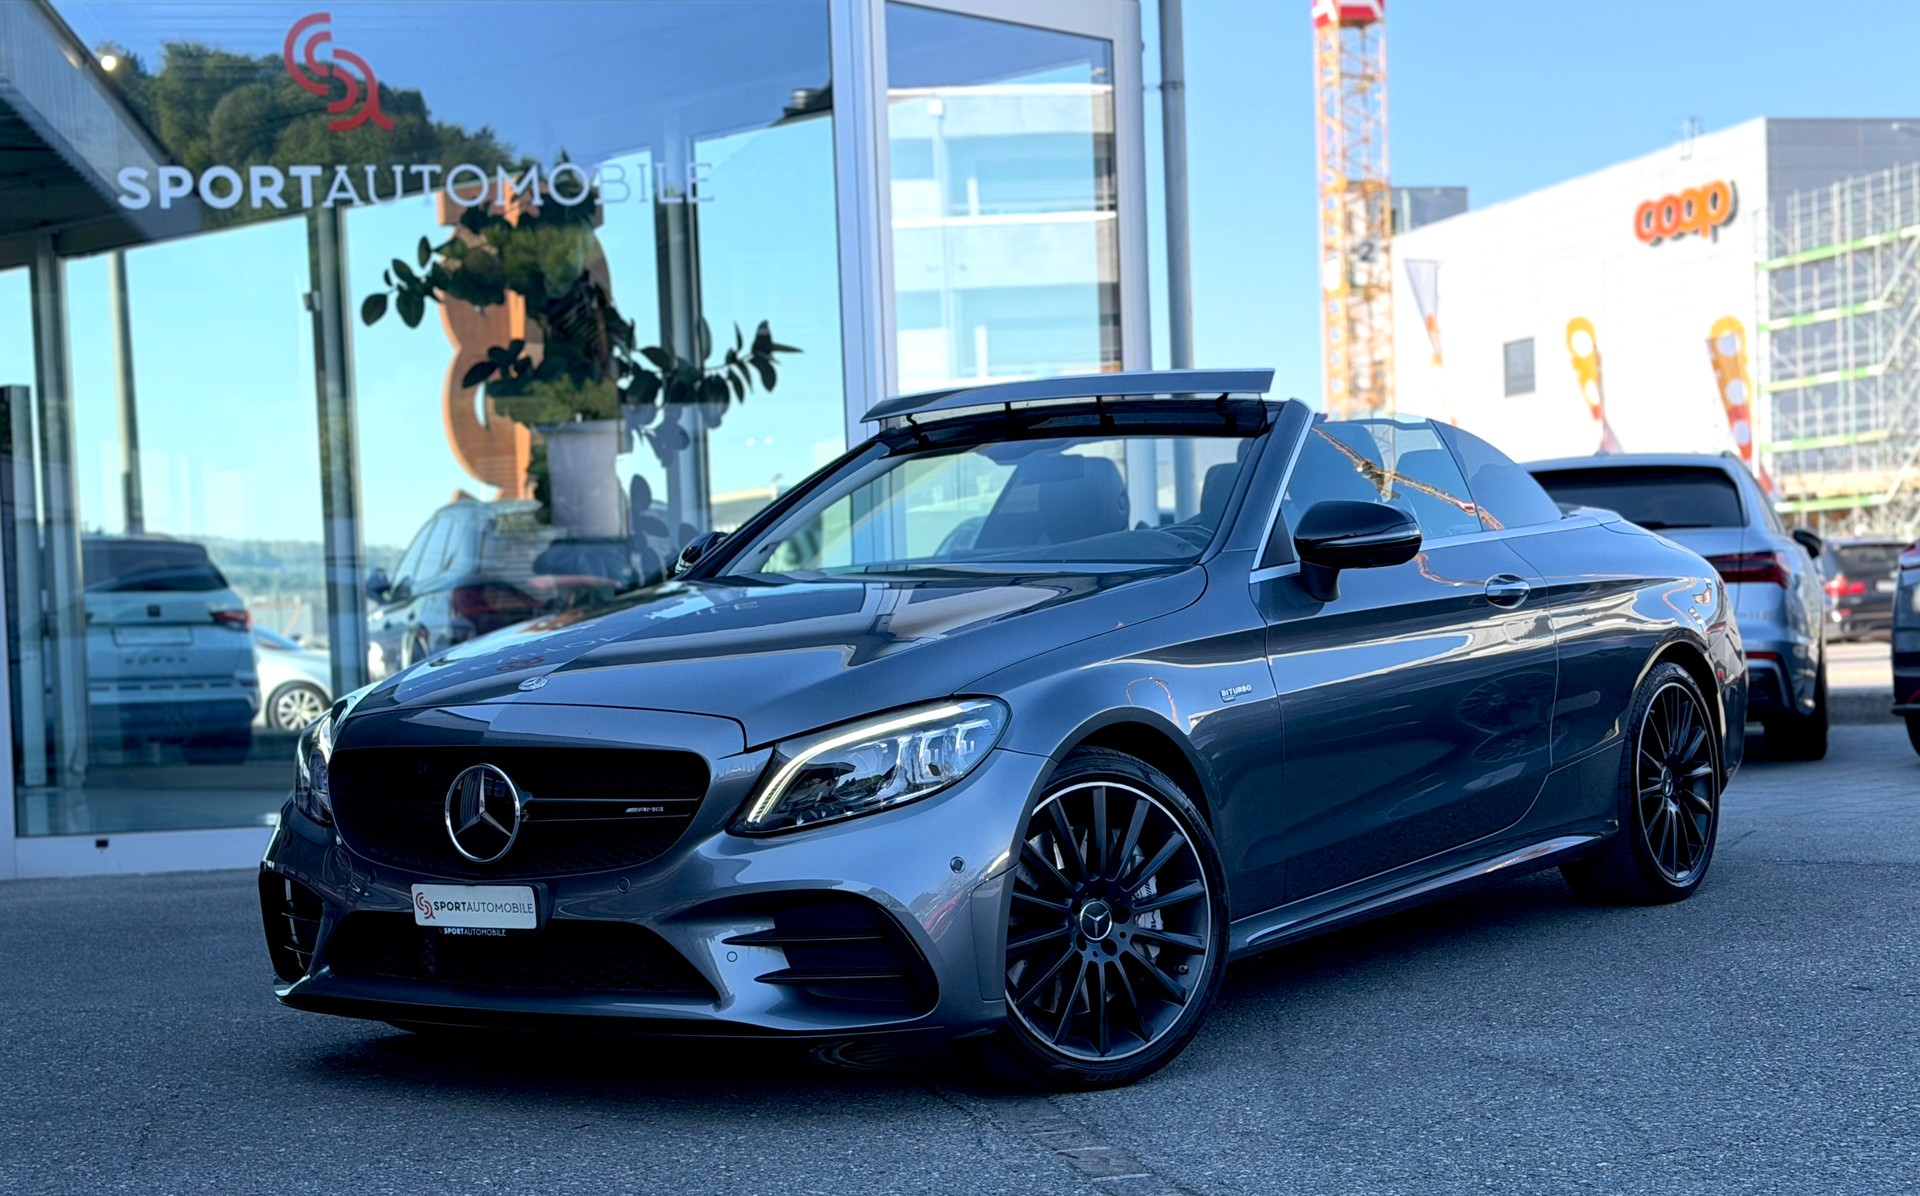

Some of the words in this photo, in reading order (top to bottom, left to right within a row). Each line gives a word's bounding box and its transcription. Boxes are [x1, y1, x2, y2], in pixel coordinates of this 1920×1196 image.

[117, 162, 715, 210] SPORTAUTOMOBILE
[1633, 180, 1732, 244] coop
[1221, 684, 1252, 697] BITURBO
[433, 901, 534, 914] SPORTAUTOMOBILE
[443, 927, 507, 937] SPORTAUTOMOBILE
